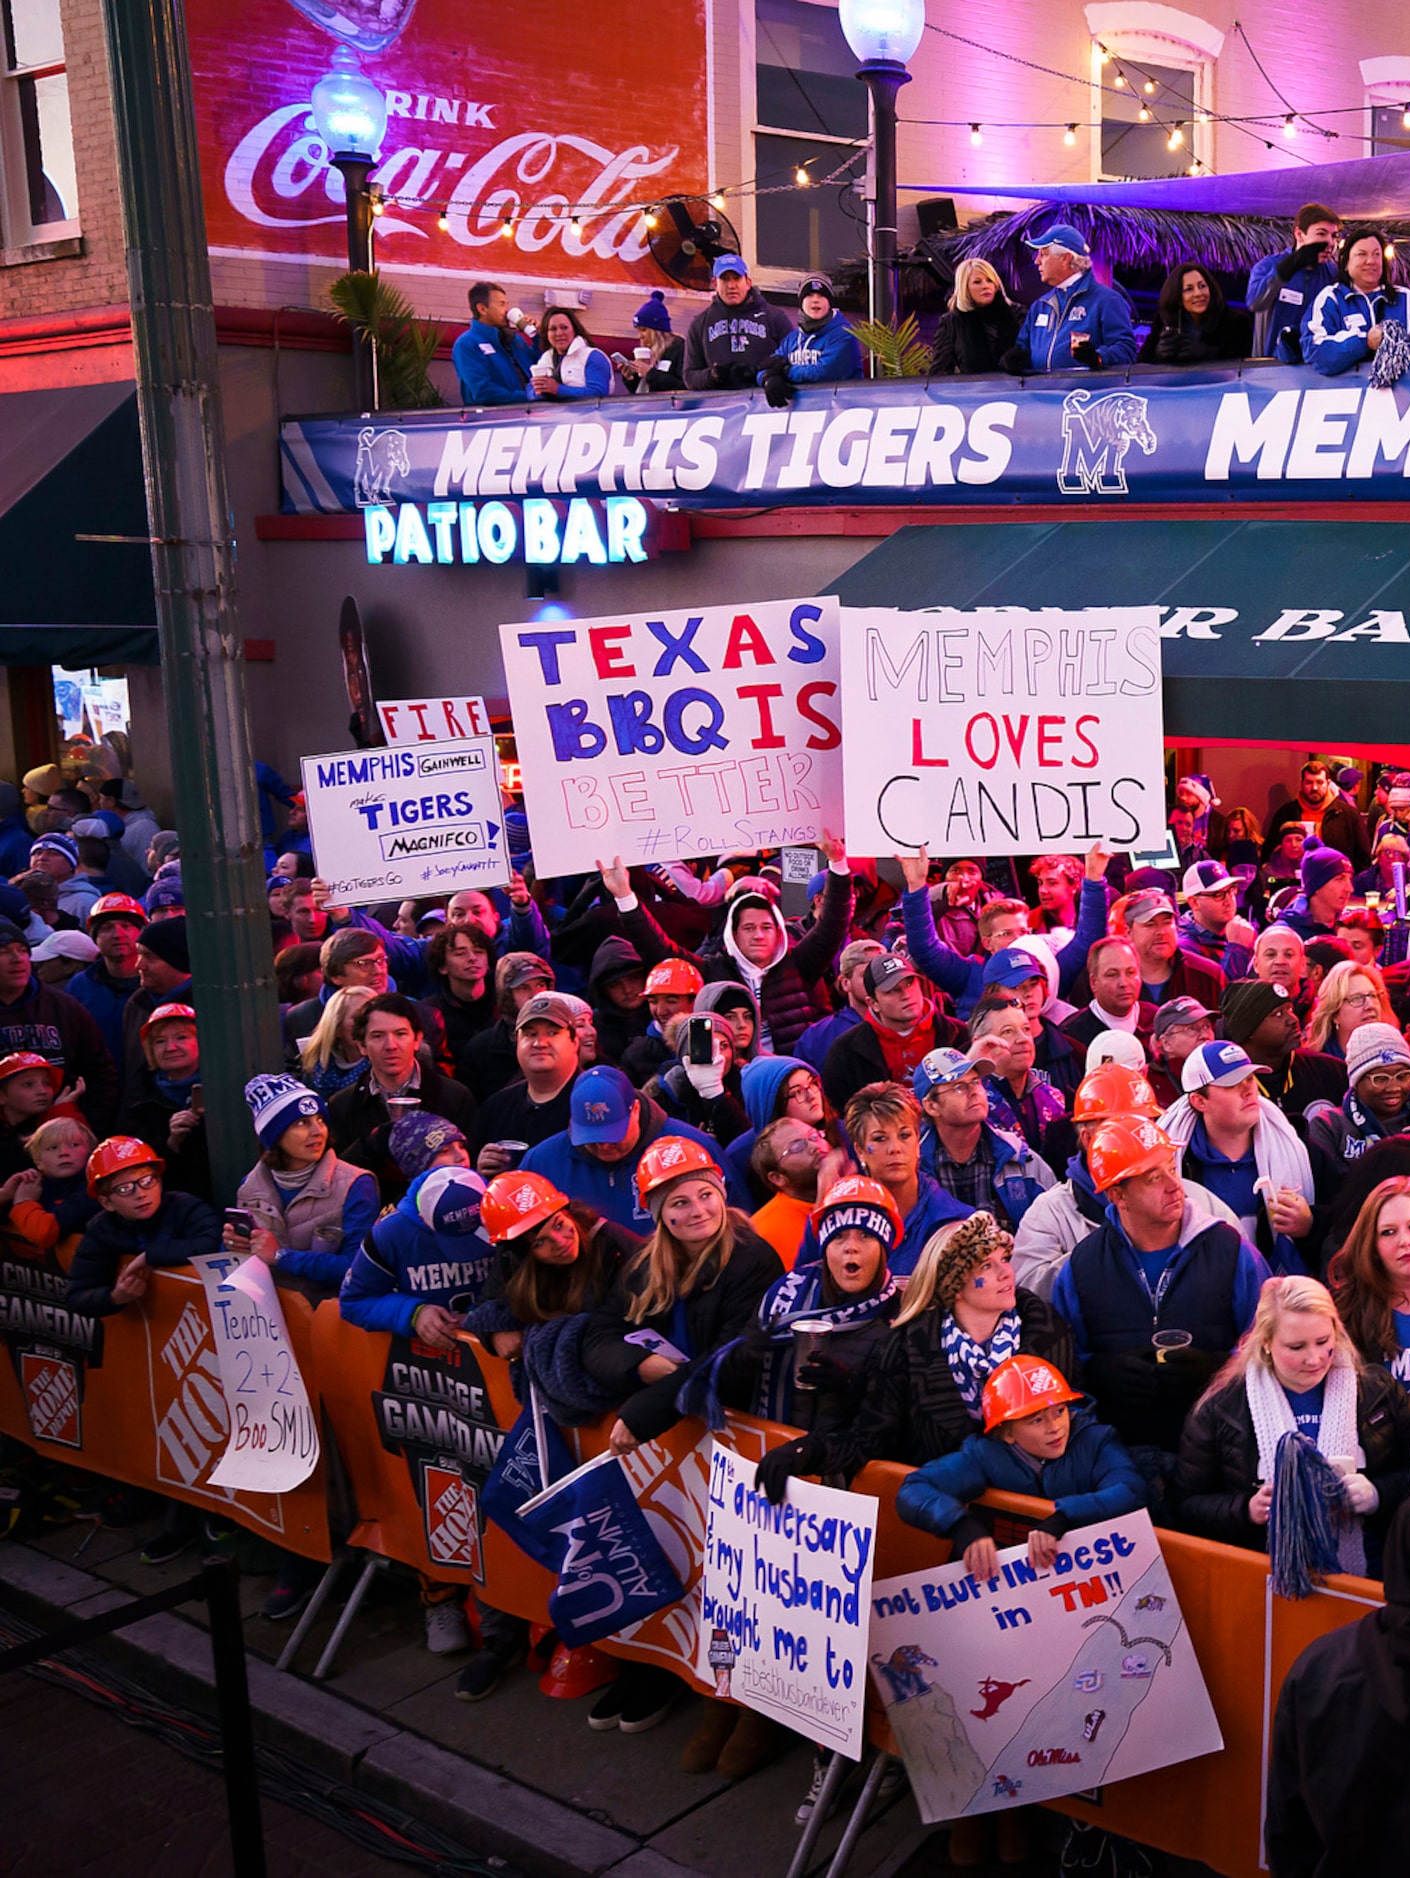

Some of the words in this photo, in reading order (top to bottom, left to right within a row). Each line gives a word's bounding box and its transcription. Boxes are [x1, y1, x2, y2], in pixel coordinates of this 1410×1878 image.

[384, 90, 496, 130] RINK
[433, 417, 724, 496] MEMPHIS
[744, 401, 1017, 489] TIGERS
[364, 501, 517, 565] PATIO
[523, 496, 649, 564] BAR
[517, 604, 826, 685] TEXAS
[866, 626, 1160, 703] MEMPHIS
[381, 700, 488, 741] FIRE
[545, 687, 730, 761] BBQ
[736, 681, 842, 750] IS
[912, 711, 1100, 769] LOVES
[317, 752, 414, 788] MEMPHIS
[421, 755, 481, 773] GAINWELL
[561, 753, 821, 830] BETTER
[359, 791, 473, 831] TIGERS
[877, 775, 1145, 849] CANDIS
[819, 1208, 891, 1245] MEMPHIS
[3, 1262, 69, 1297] COLLEG
[407, 1259, 490, 1291] MEMPH
[160, 1301, 209, 1381] THE
[214, 1301, 281, 1341] Teache
[157, 1348, 231, 1489] HO
[391, 1362, 484, 1418] COLLEGE
[621, 1438, 674, 1492] HE
[586, 1504, 659, 1598] ALUMNI
[734, 1482, 871, 1583] anniversary
[718, 1538, 744, 1601] my
[755, 1534, 860, 1627] husband
[873, 1588, 920, 1619] not
[1053, 1532, 1136, 1576] best
[703, 1575, 761, 1656] brought
[773, 1626, 808, 1672] me
[827, 1637, 853, 1690] to
[992, 1606, 1032, 1631] in
